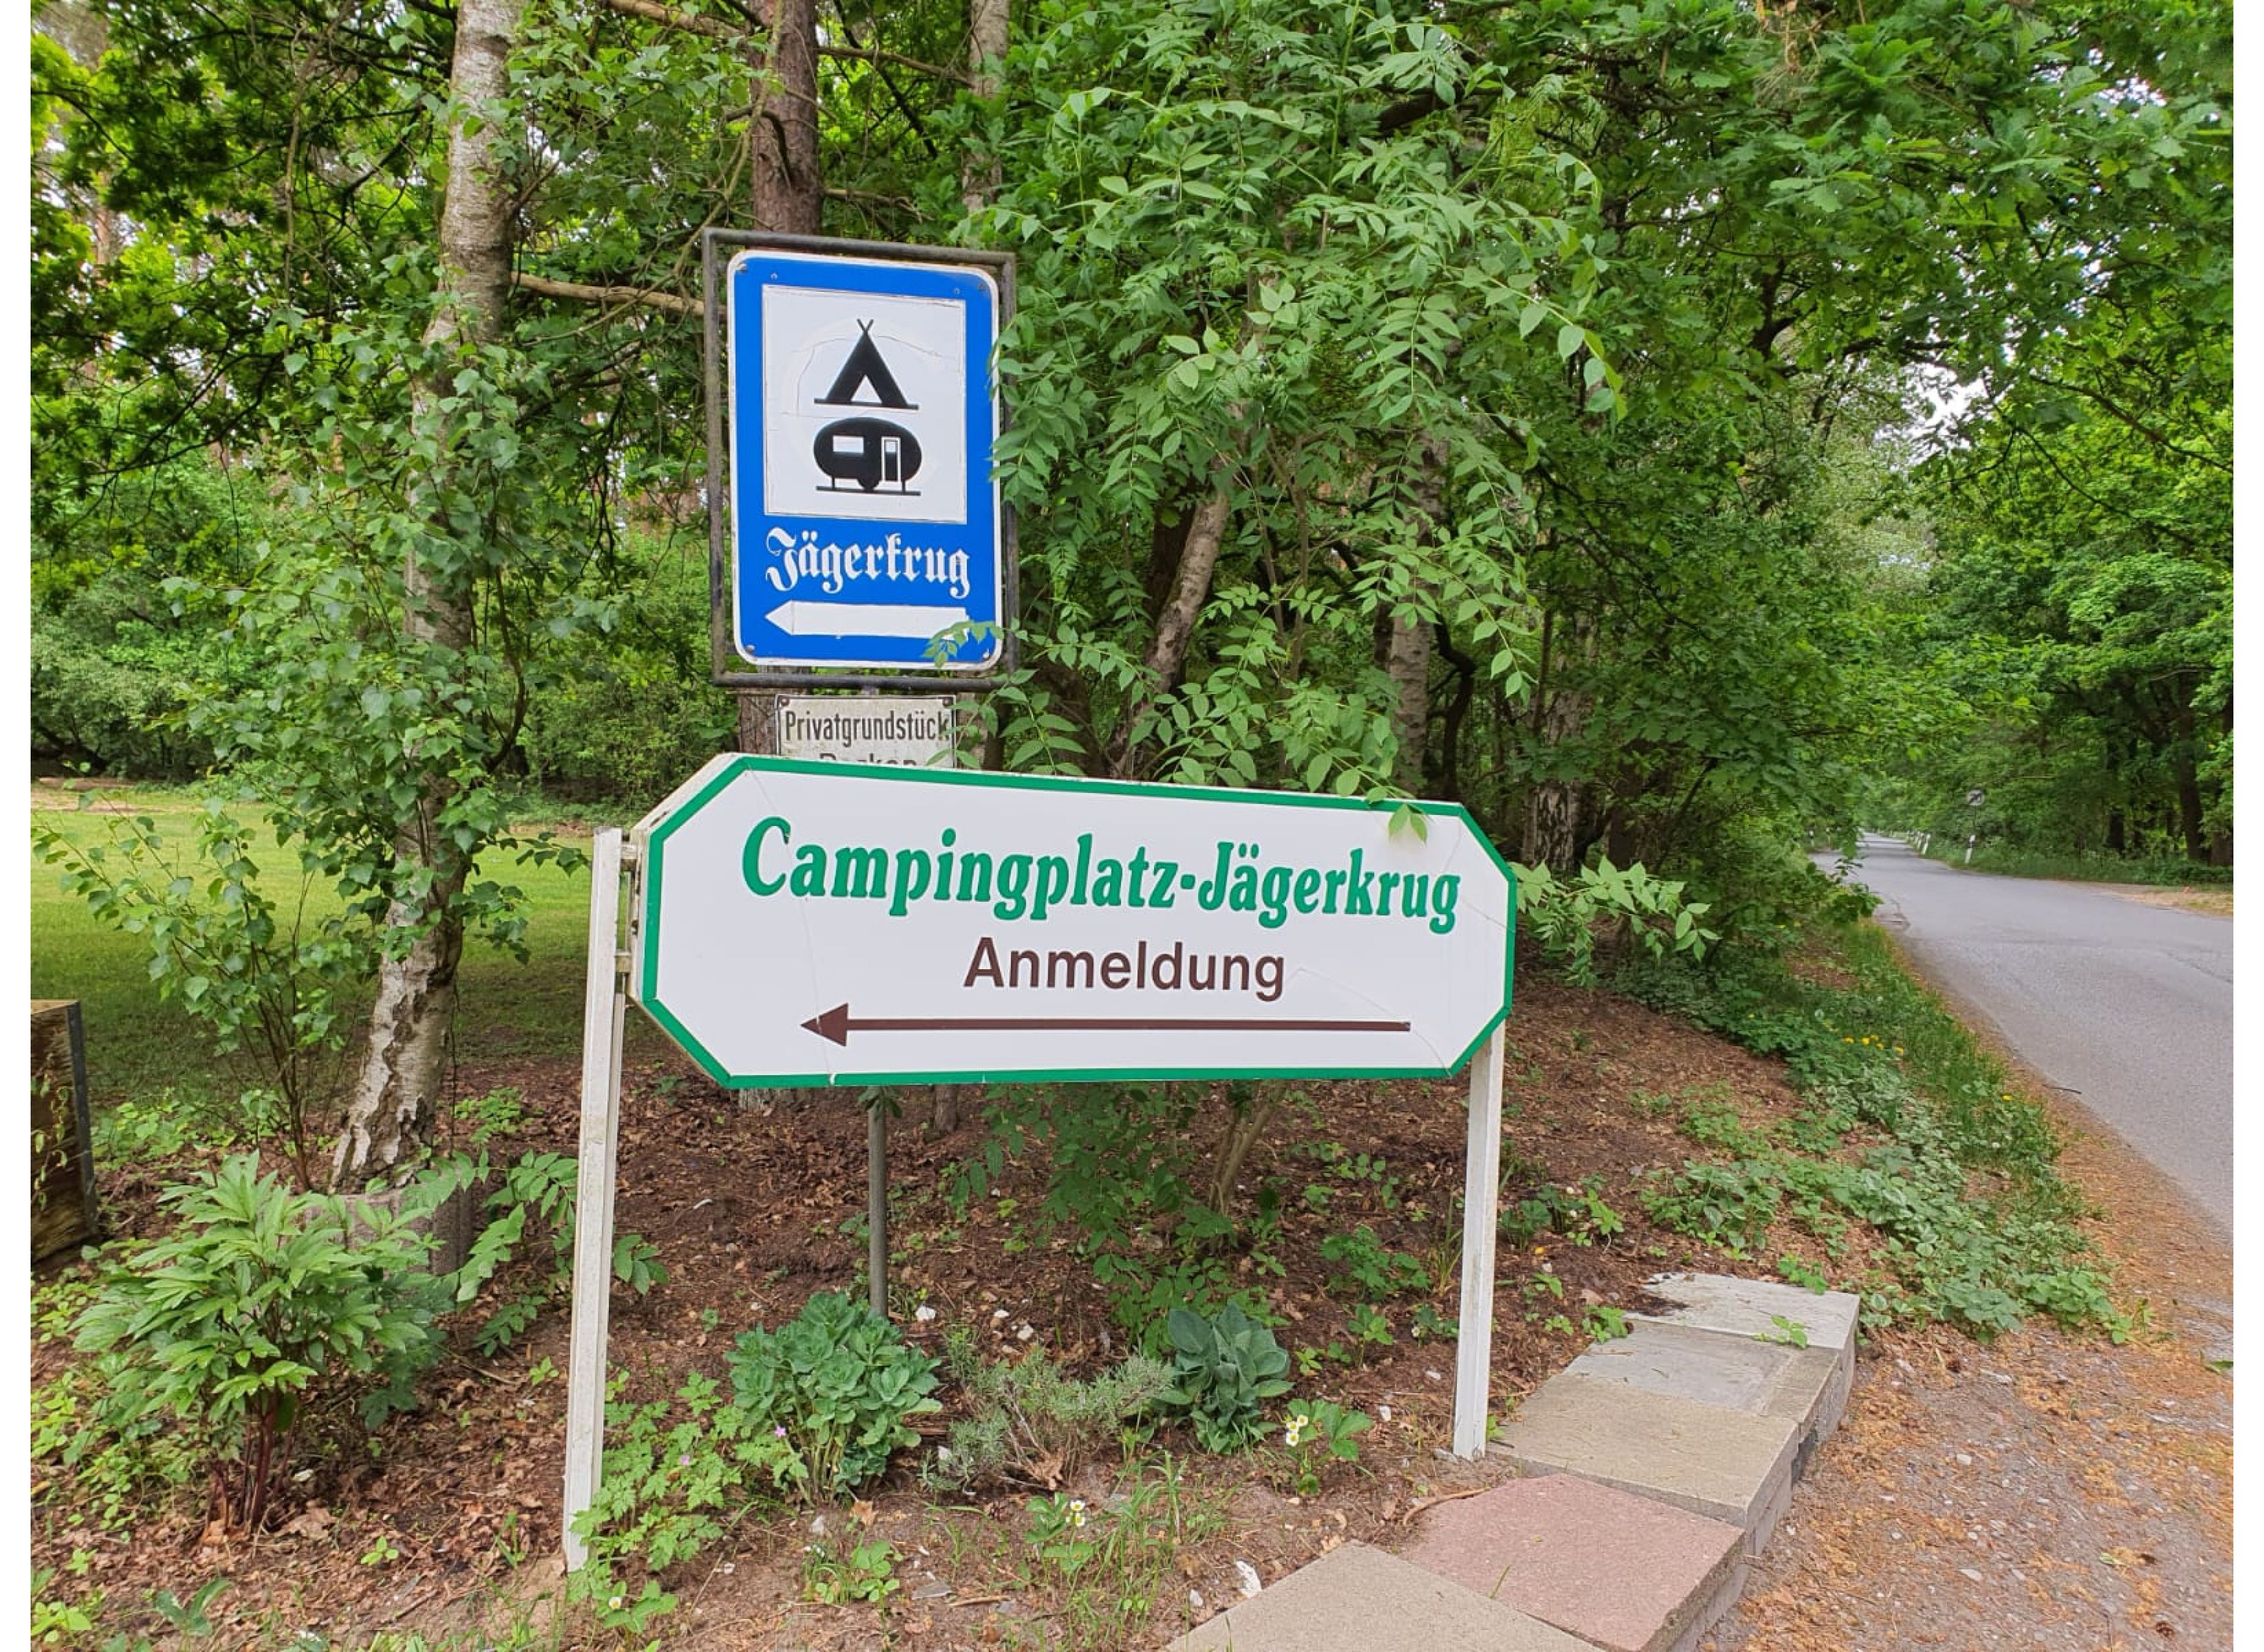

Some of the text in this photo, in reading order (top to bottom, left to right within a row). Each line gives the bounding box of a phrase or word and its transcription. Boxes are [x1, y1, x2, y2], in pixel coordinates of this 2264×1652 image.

[765, 527, 970, 598] Jägerkrug
[786, 710, 949, 748] Privatgrundstück
[742, 817, 1461, 934] Campingplatz-Jägerkrug
[964, 937, 1284, 1002] Anmeldung
